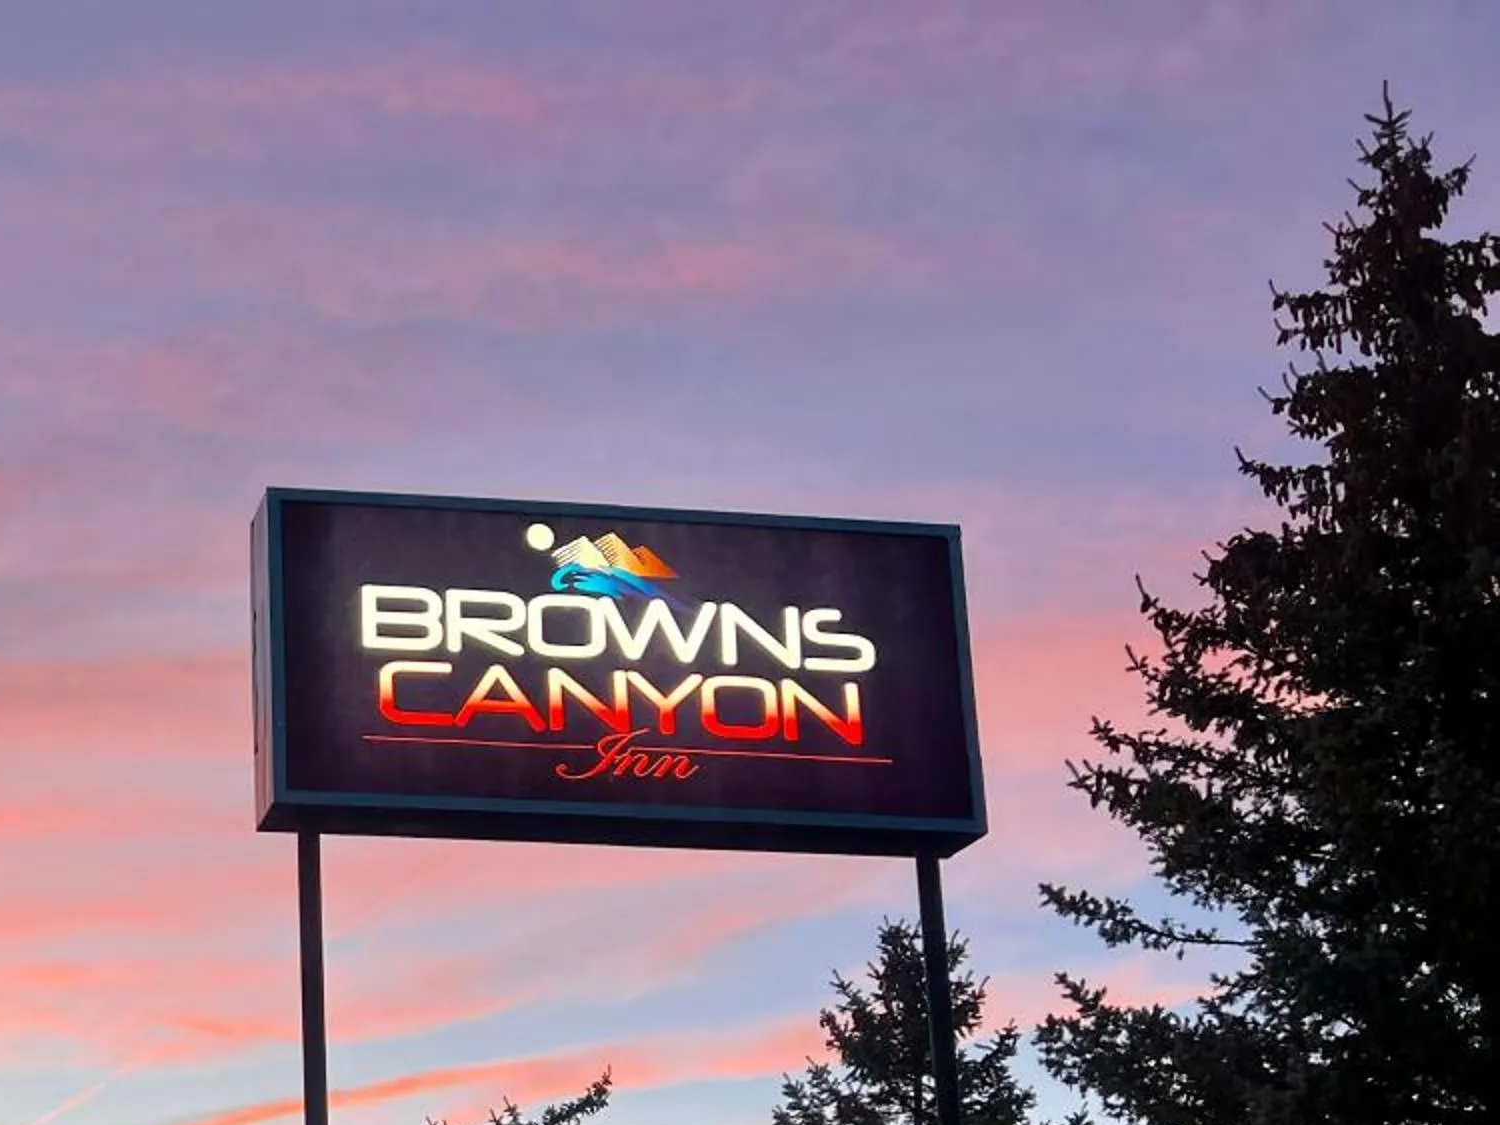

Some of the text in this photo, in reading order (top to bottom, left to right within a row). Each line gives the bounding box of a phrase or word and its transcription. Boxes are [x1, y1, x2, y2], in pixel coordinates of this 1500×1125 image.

[360, 584, 876, 673] BROWNS
[378, 660, 863, 745] CANYON
[555, 729, 699, 780] Inn
